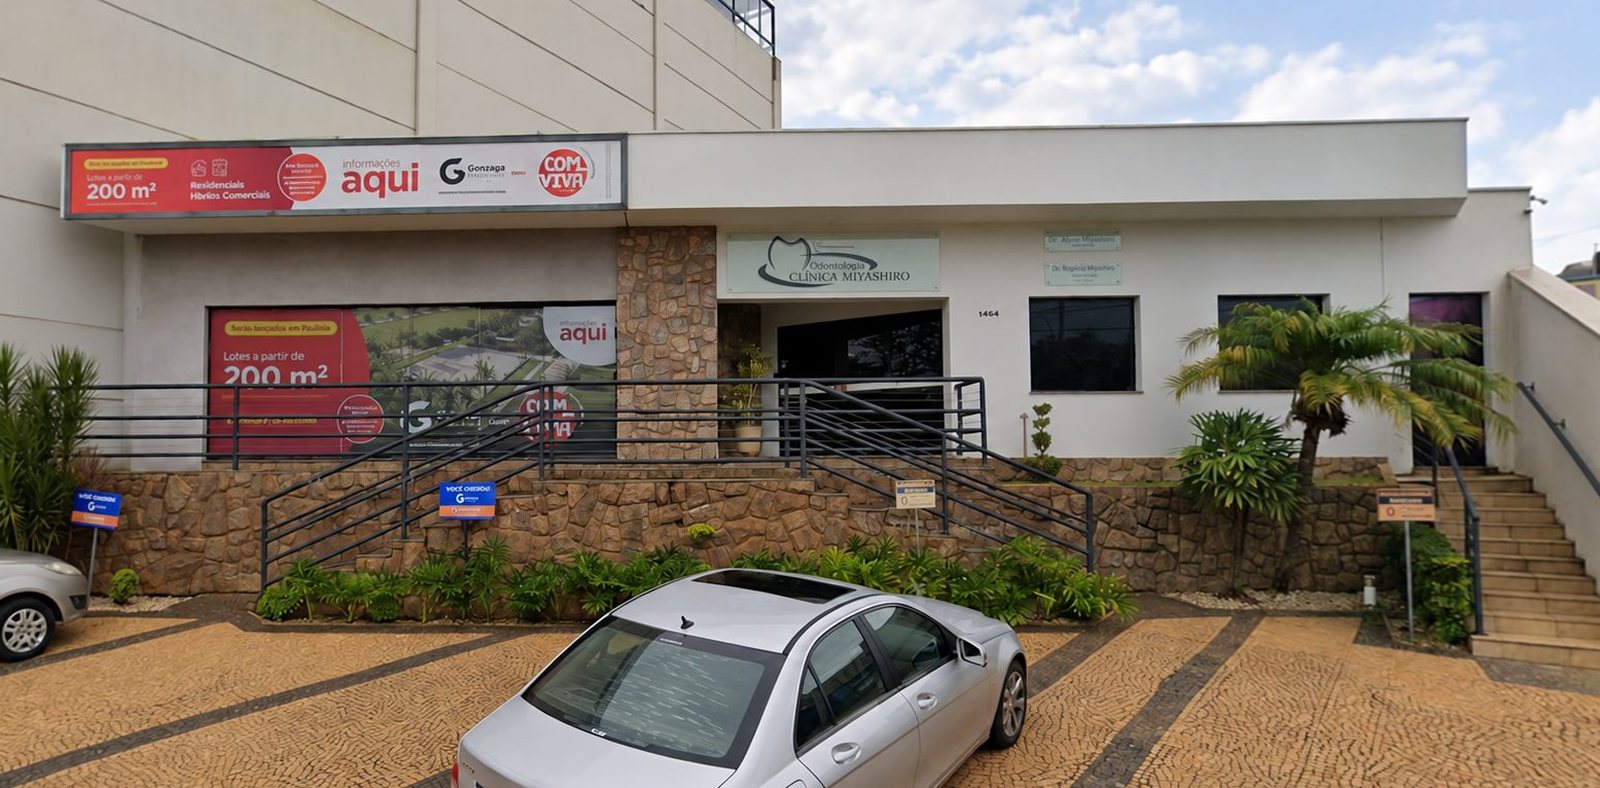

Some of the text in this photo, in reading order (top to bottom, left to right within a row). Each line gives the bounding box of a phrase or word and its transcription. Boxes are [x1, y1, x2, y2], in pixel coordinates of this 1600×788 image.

[342, 158, 401, 169] informações
[467, 164, 505, 173] Gonzaga
[544, 155, 587, 172] COM
[190, 180, 245, 189] Residenciais
[341, 162, 418, 198] aqui
[538, 173, 583, 188] VIVA
[86, 182, 157, 200] 200 m²
[222, 189, 271, 200] Comerciais
[809, 261, 865, 271] Odontologia
[788, 270, 910, 281] CLÍNICA MIYASHIRO
[560, 322, 606, 345] aqui
[223, 352, 251, 360] Lotes
[261, 352, 288, 362] partir
[291, 351, 305, 360] de
[224, 364, 328, 389] 200 m²
